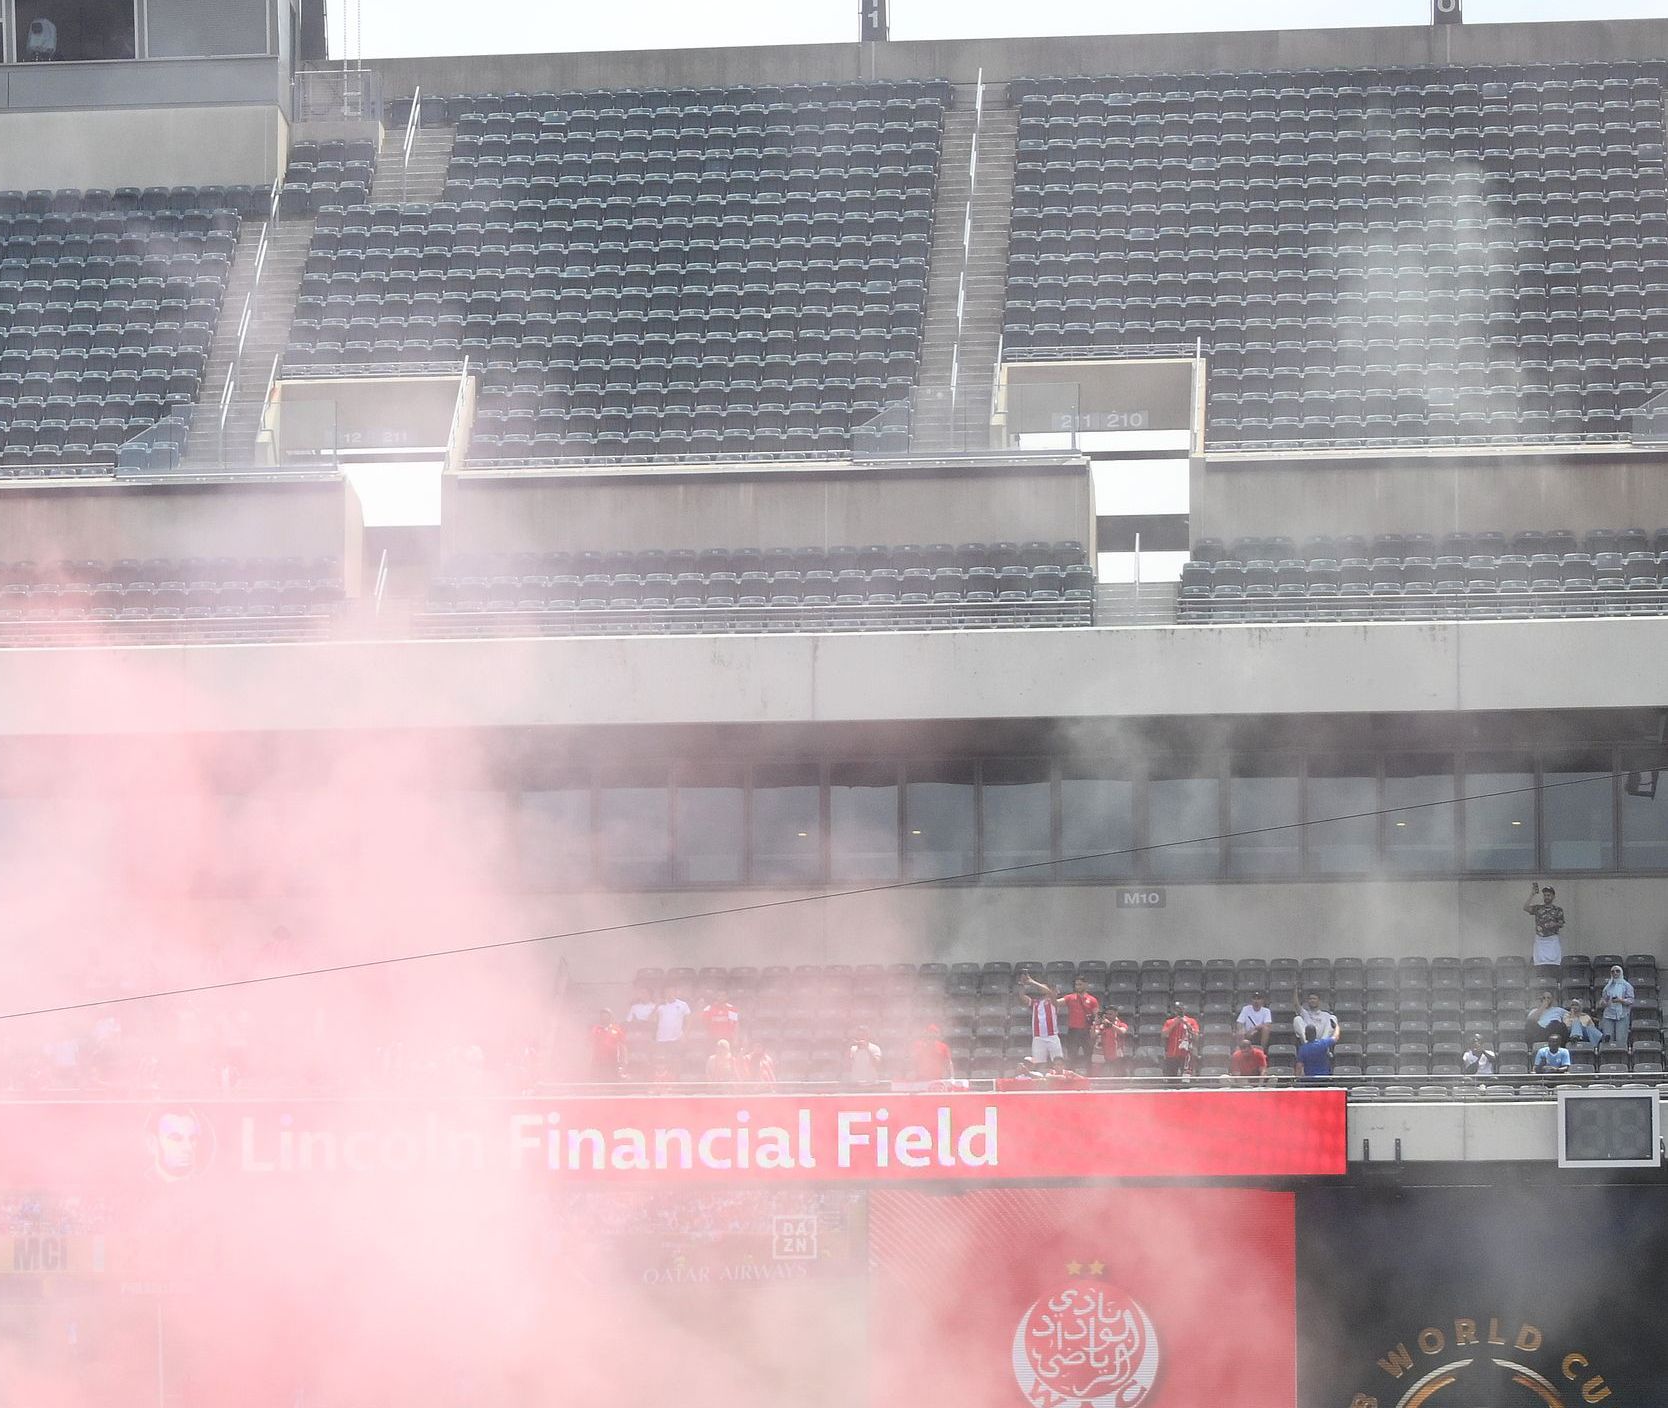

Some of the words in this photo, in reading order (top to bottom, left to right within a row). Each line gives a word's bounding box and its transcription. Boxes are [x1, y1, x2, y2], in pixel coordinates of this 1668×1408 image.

[1106, 414, 1143, 427] 210
[1123, 892, 1160, 904] M10
[240, 1110, 485, 1176] Lincoln
[509, 1108, 814, 1172] Financial
[836, 1105, 1000, 1167] Field
[643, 1267, 710, 1286] QATAR
[719, 1264, 809, 1283] AIRWAYS
[1377, 1316, 1544, 1380] WORLD
